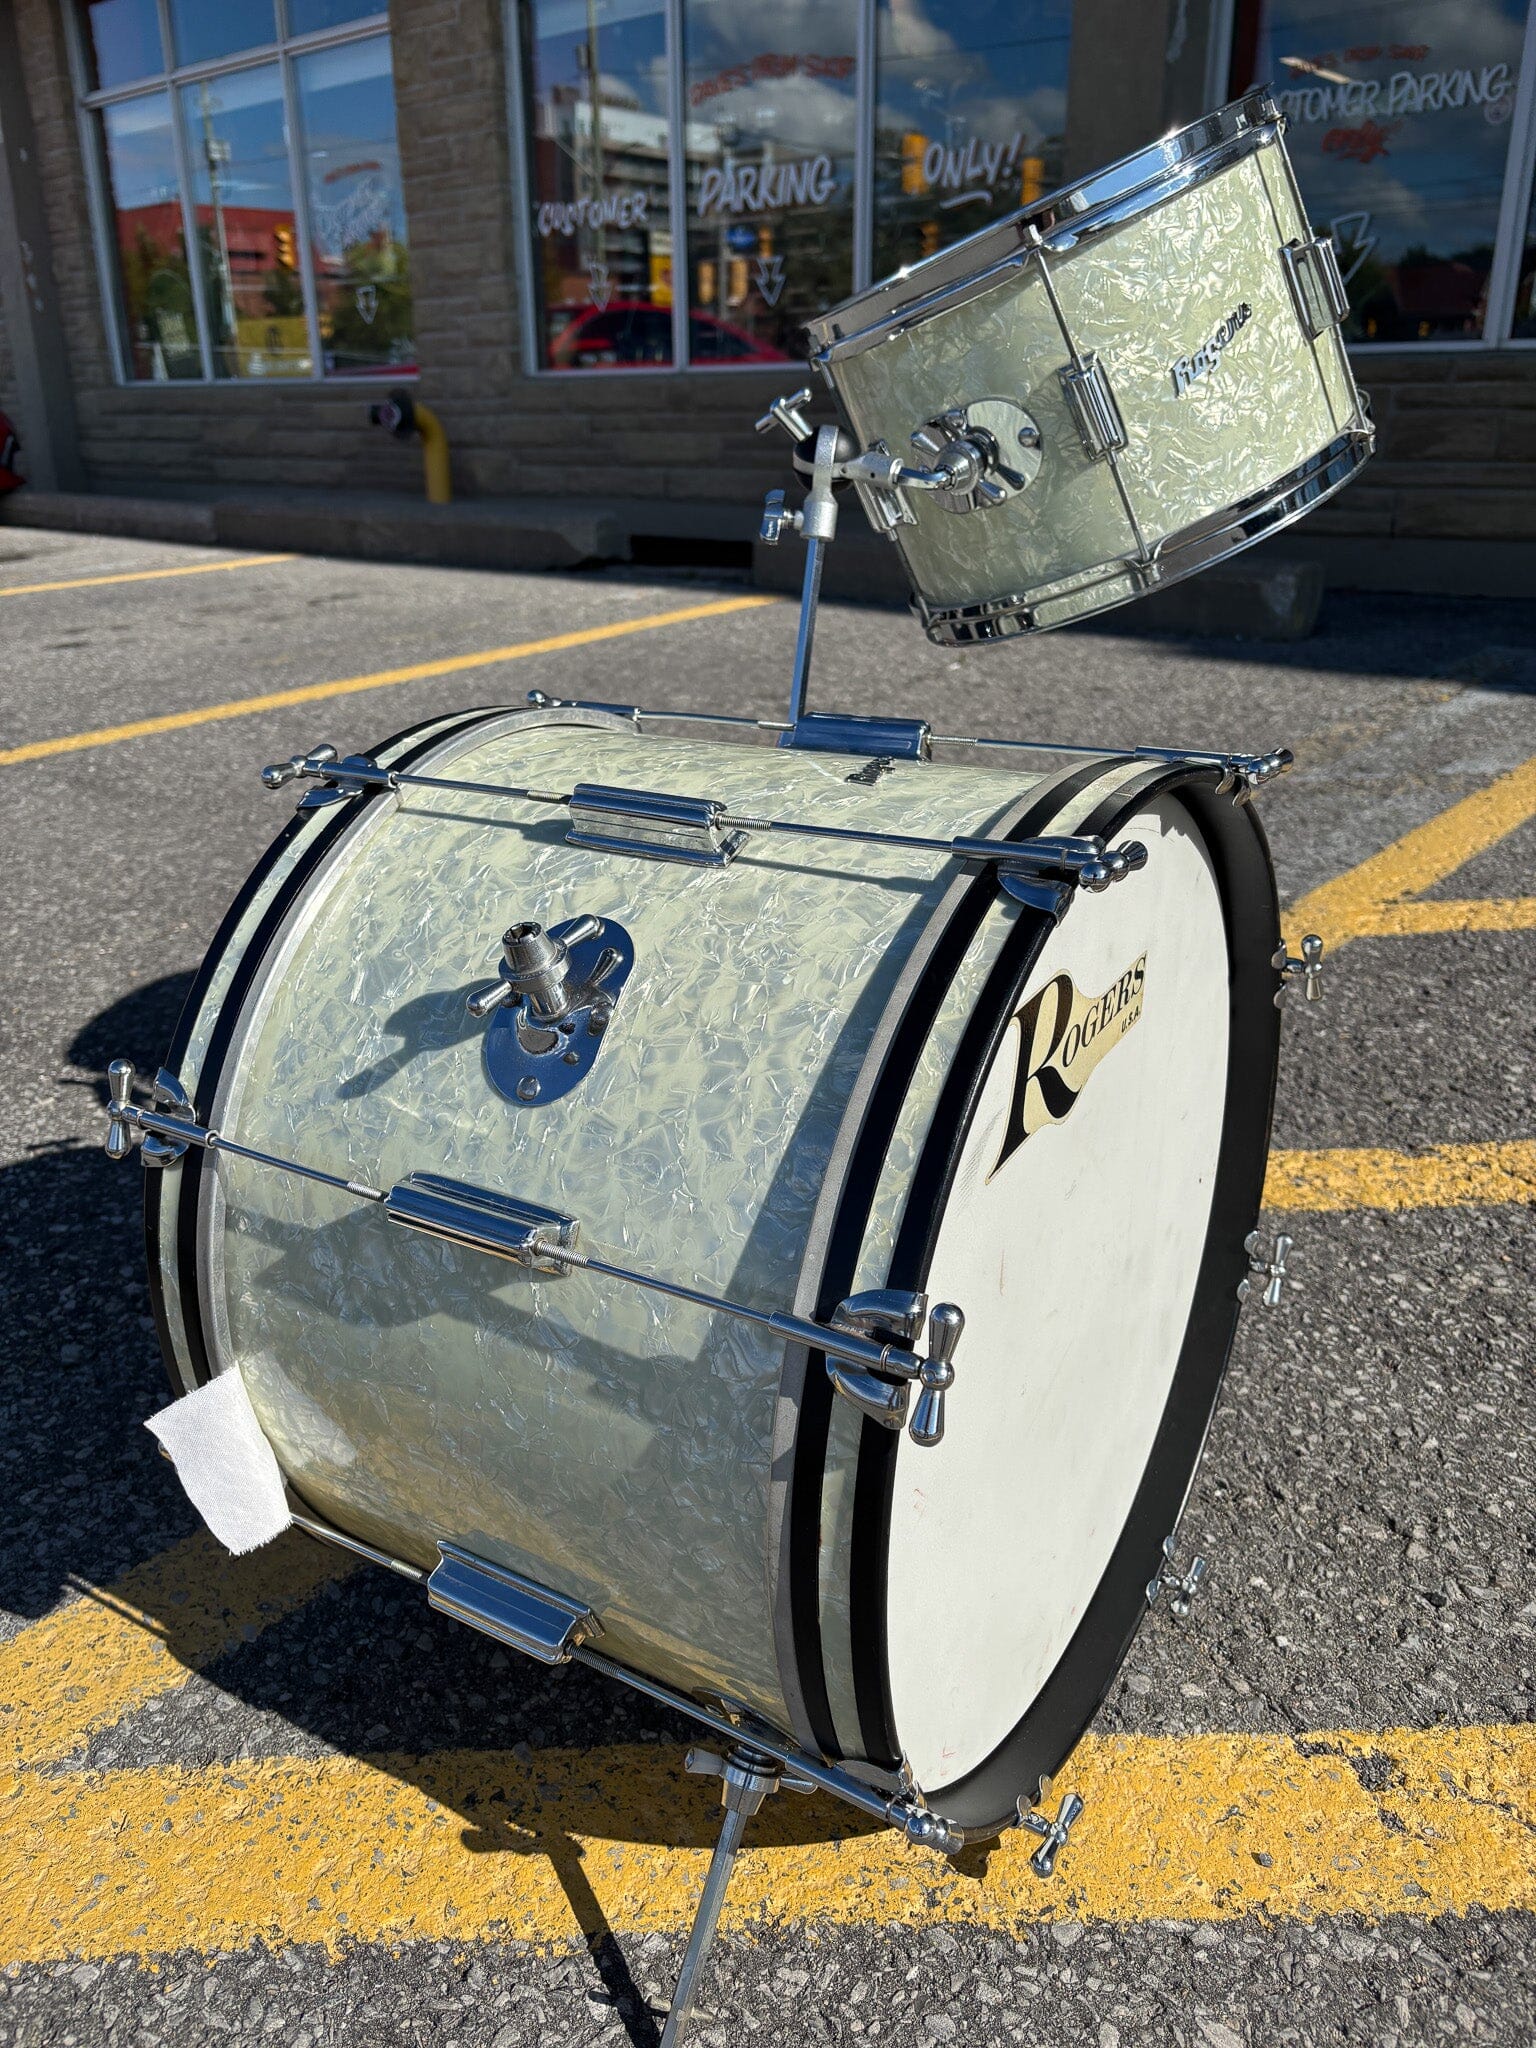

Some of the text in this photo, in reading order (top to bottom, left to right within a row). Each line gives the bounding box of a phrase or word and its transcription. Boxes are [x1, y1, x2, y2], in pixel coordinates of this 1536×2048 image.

[1386, 63, 1511, 116] PARKING
[538, 132, 1022, 236] CUSTOMER PARKING ONLY!
[1169, 302, 1252, 398] Rogers
[1121, 1005, 1141, 1033] U.S.A.
